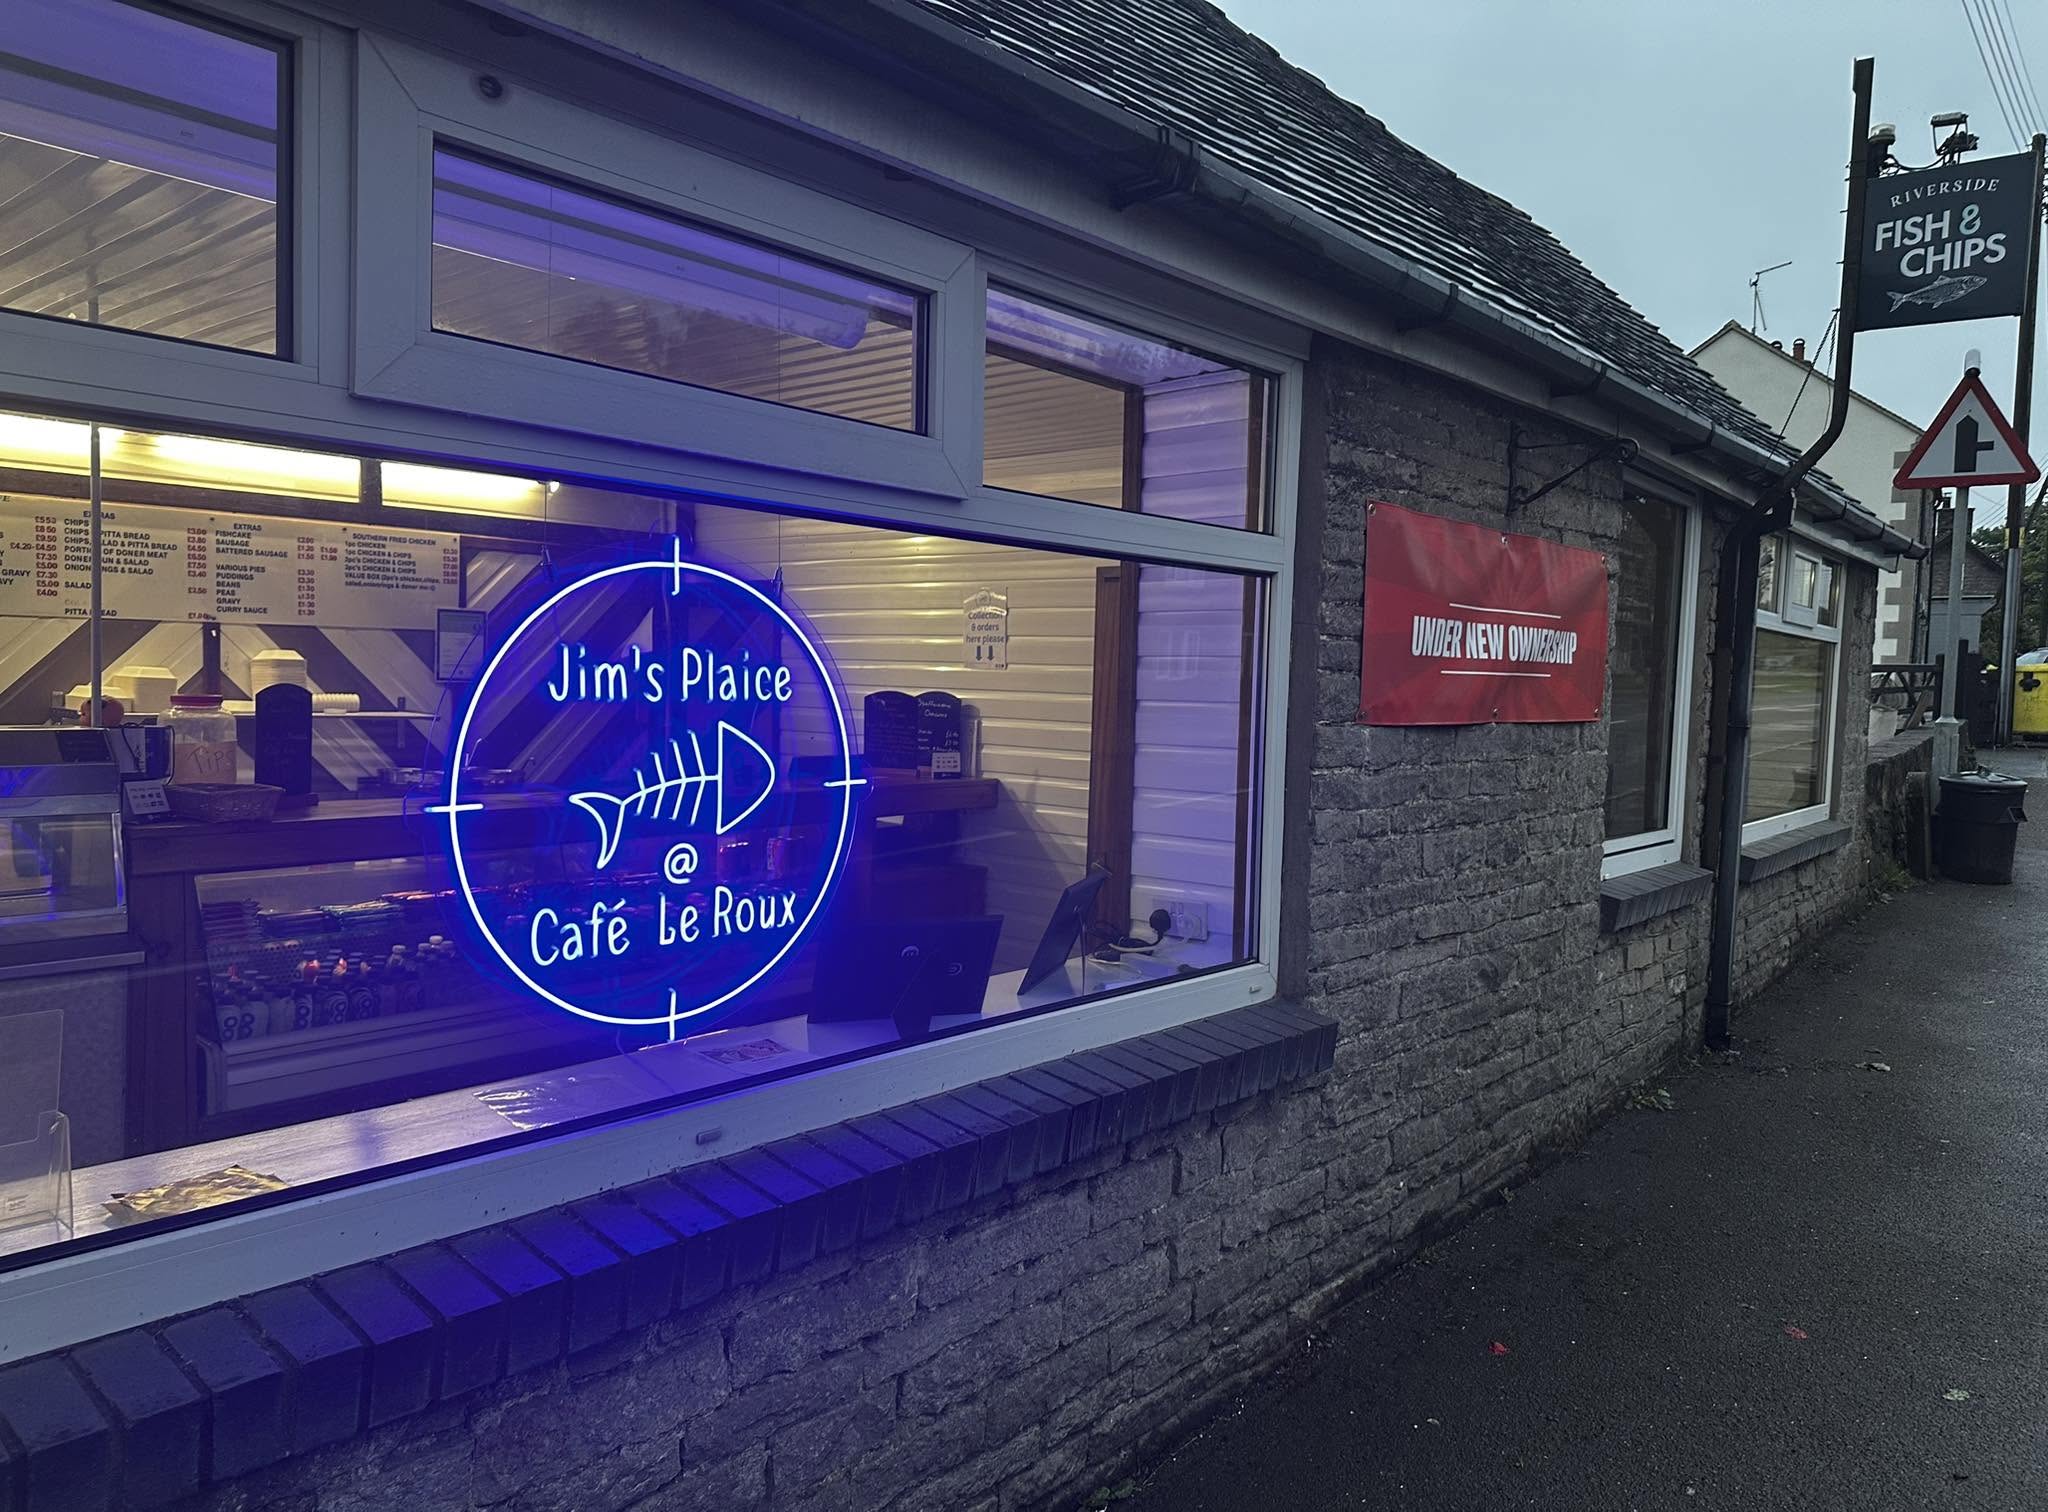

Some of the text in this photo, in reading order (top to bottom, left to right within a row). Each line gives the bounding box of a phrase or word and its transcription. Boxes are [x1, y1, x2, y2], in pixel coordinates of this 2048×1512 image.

[1890, 178, 2000, 207] RIVERSIDE
[1875, 204, 1981, 252] FISH &
[1900, 233, 2007, 278] CHIPS
[64, 519, 90, 527] CHIPS
[233, 523, 262, 531] EXTRAS
[64, 527, 90, 536] CHIPS
[123, 532, 151, 540] BREAD
[216, 530, 252, 538] FISHCAKE
[127, 541, 150, 549] PITTA
[151, 543, 176, 551] BREAD
[216, 539, 250, 547] SAUSAGE
[116, 549, 145, 557] DONER
[147, 551, 168, 559] MEAT
[216, 547, 288, 558] BATTERED SAUSAGE
[123, 558, 149, 566] SALAD
[128, 567, 154, 575] SALAD
[216, 564, 248, 572] VARIOUS
[2, 569, 31, 577] GRAVY
[216, 573, 254, 581] PUDDINGS
[64, 581, 92, 589] SALAD
[216, 581, 241, 589] BEANS
[64, 608, 89, 616] PITTA
[216, 605, 268, 614] CURRY SAUCE
[977, 622, 999, 631] orders
[966, 634, 1005, 645] here please
[1411, 616, 1577, 665] UNDER NEW OWNERSHIP
[548, 643, 664, 702] Jim's
[681, 647, 793, 703] Plaice
[663, 842, 699, 884] @
[530, 885, 797, 966] Café Le Roux
